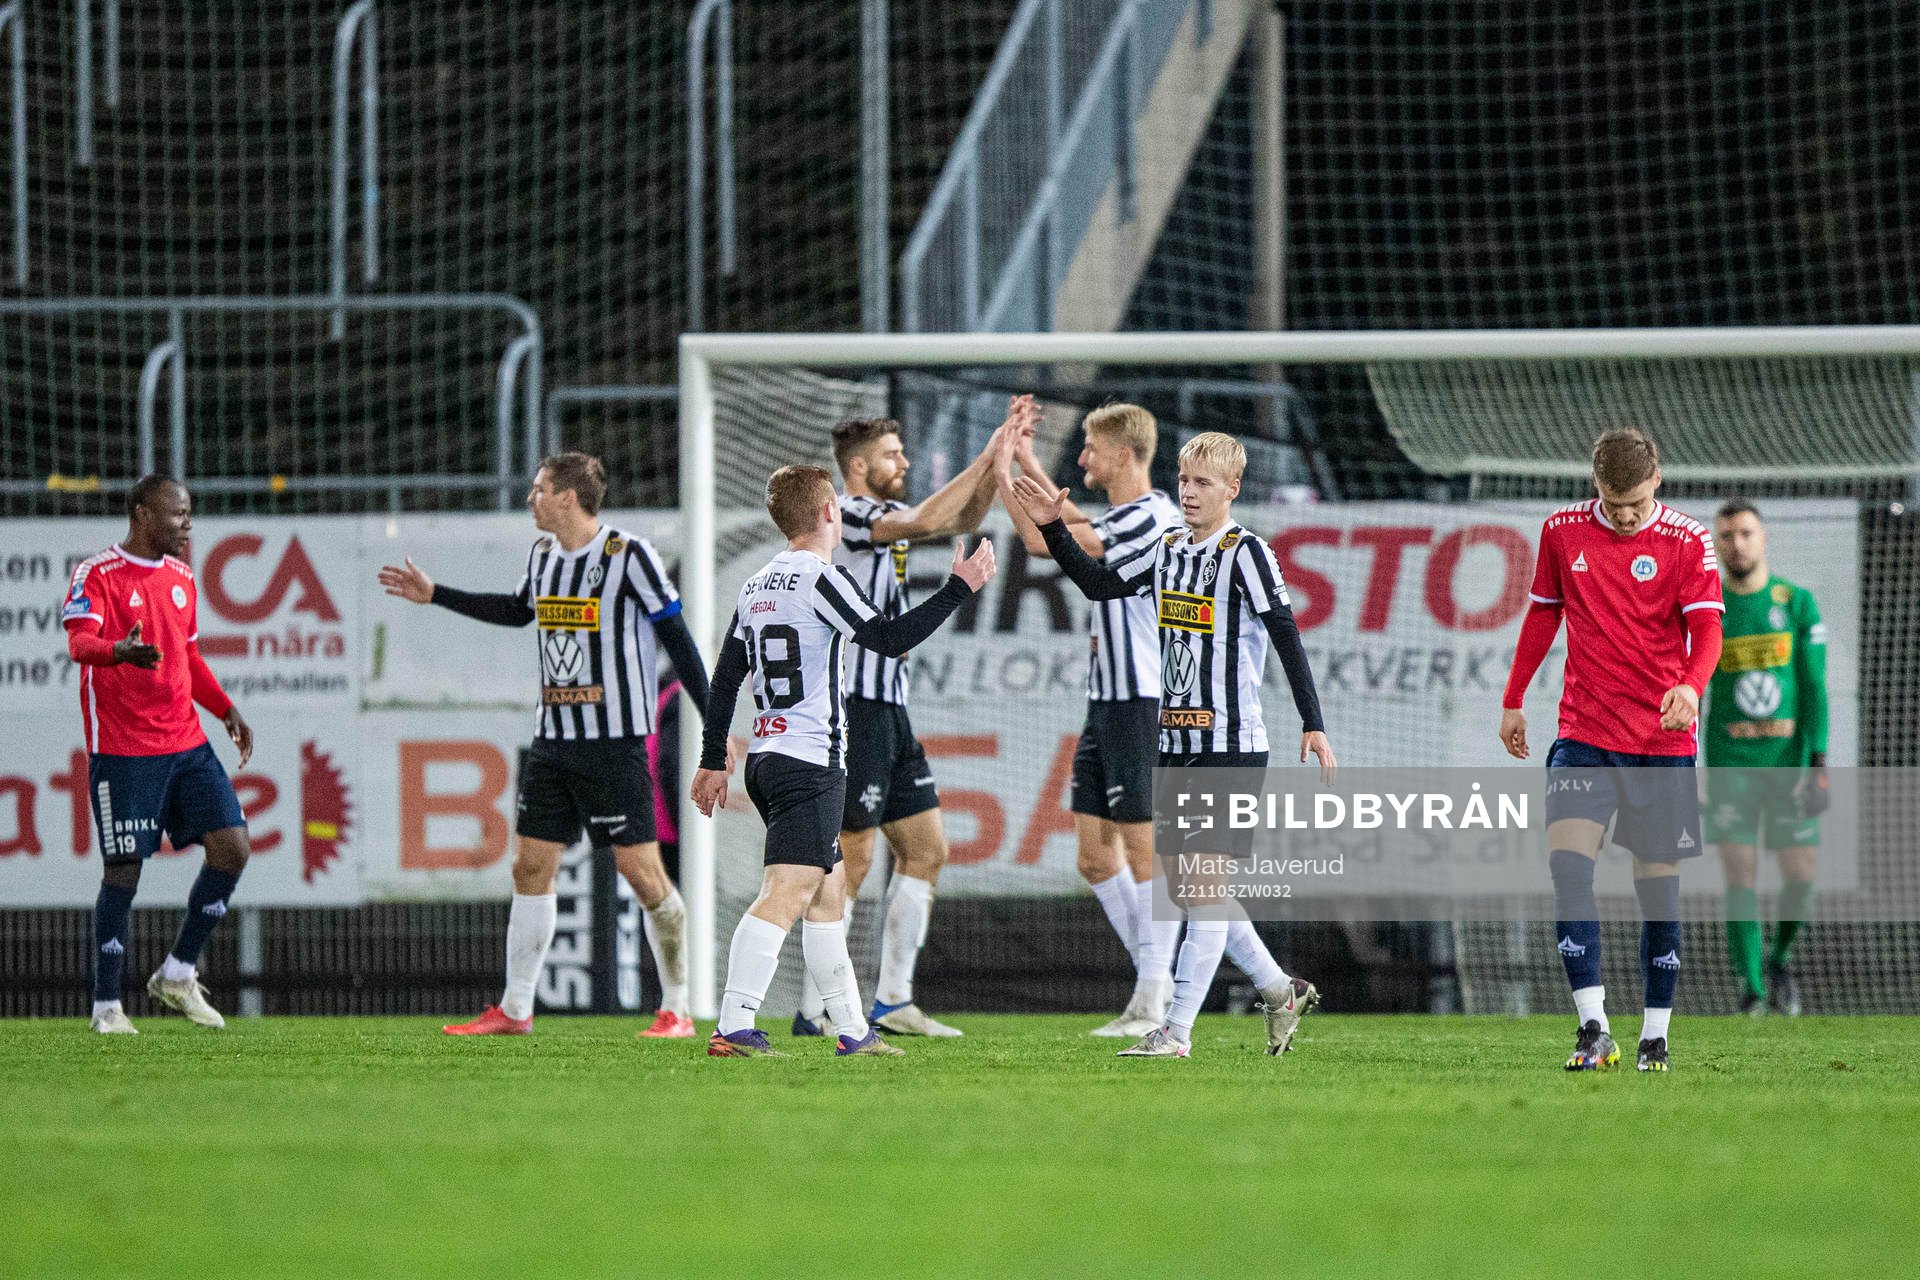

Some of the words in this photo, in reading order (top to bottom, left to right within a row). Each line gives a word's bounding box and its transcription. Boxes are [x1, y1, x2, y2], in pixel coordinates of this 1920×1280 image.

[1548, 514, 1592, 530] BRIXLY
[1653, 523, 1693, 544] BRIXLY
[0, 553, 50, 581] en
[181, 531, 343, 625] CA
[117, 834, 136, 855] 19
